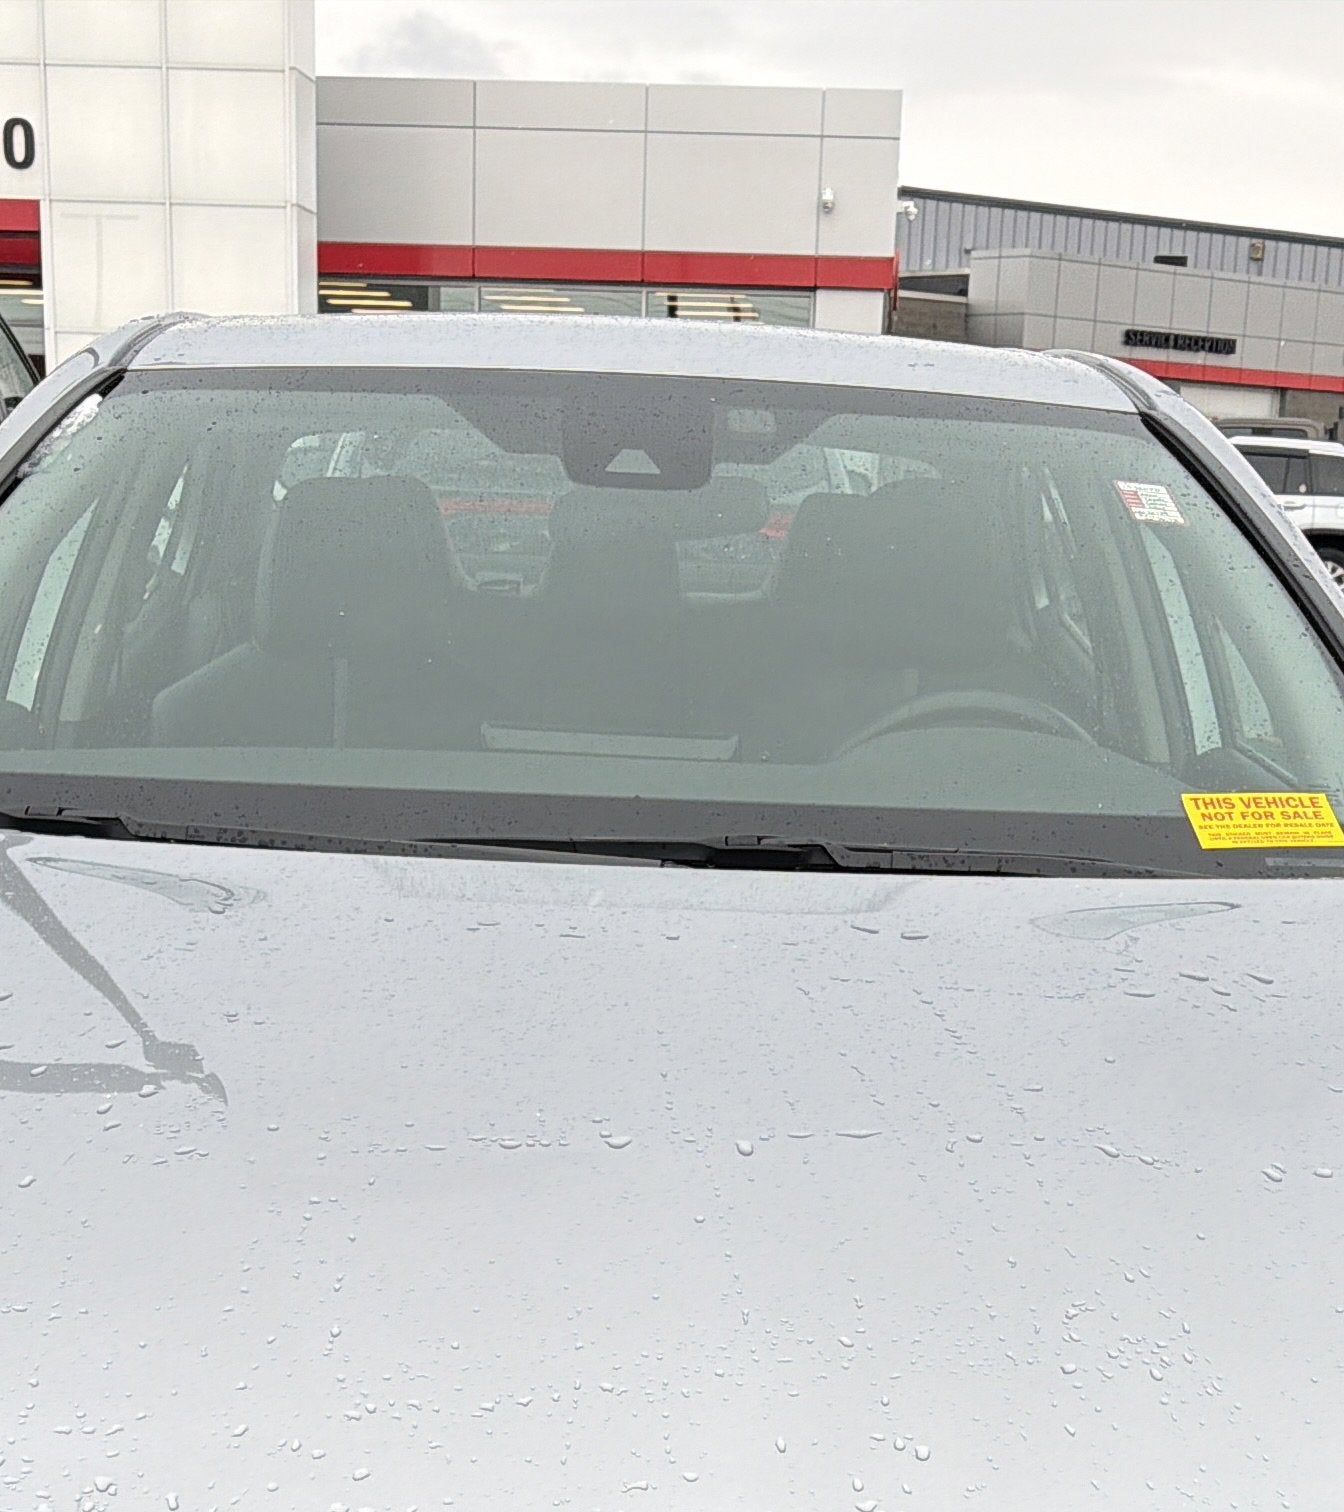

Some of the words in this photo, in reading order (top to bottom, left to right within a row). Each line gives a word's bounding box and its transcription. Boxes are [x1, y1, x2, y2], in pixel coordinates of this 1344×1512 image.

[1190, 796, 1236, 811] THIS
[1238, 796, 1324, 810] VEHICLE
[1200, 811, 1235, 822] NOT
[1239, 810, 1276, 821] FOR
[1279, 810, 1325, 821] SALE
